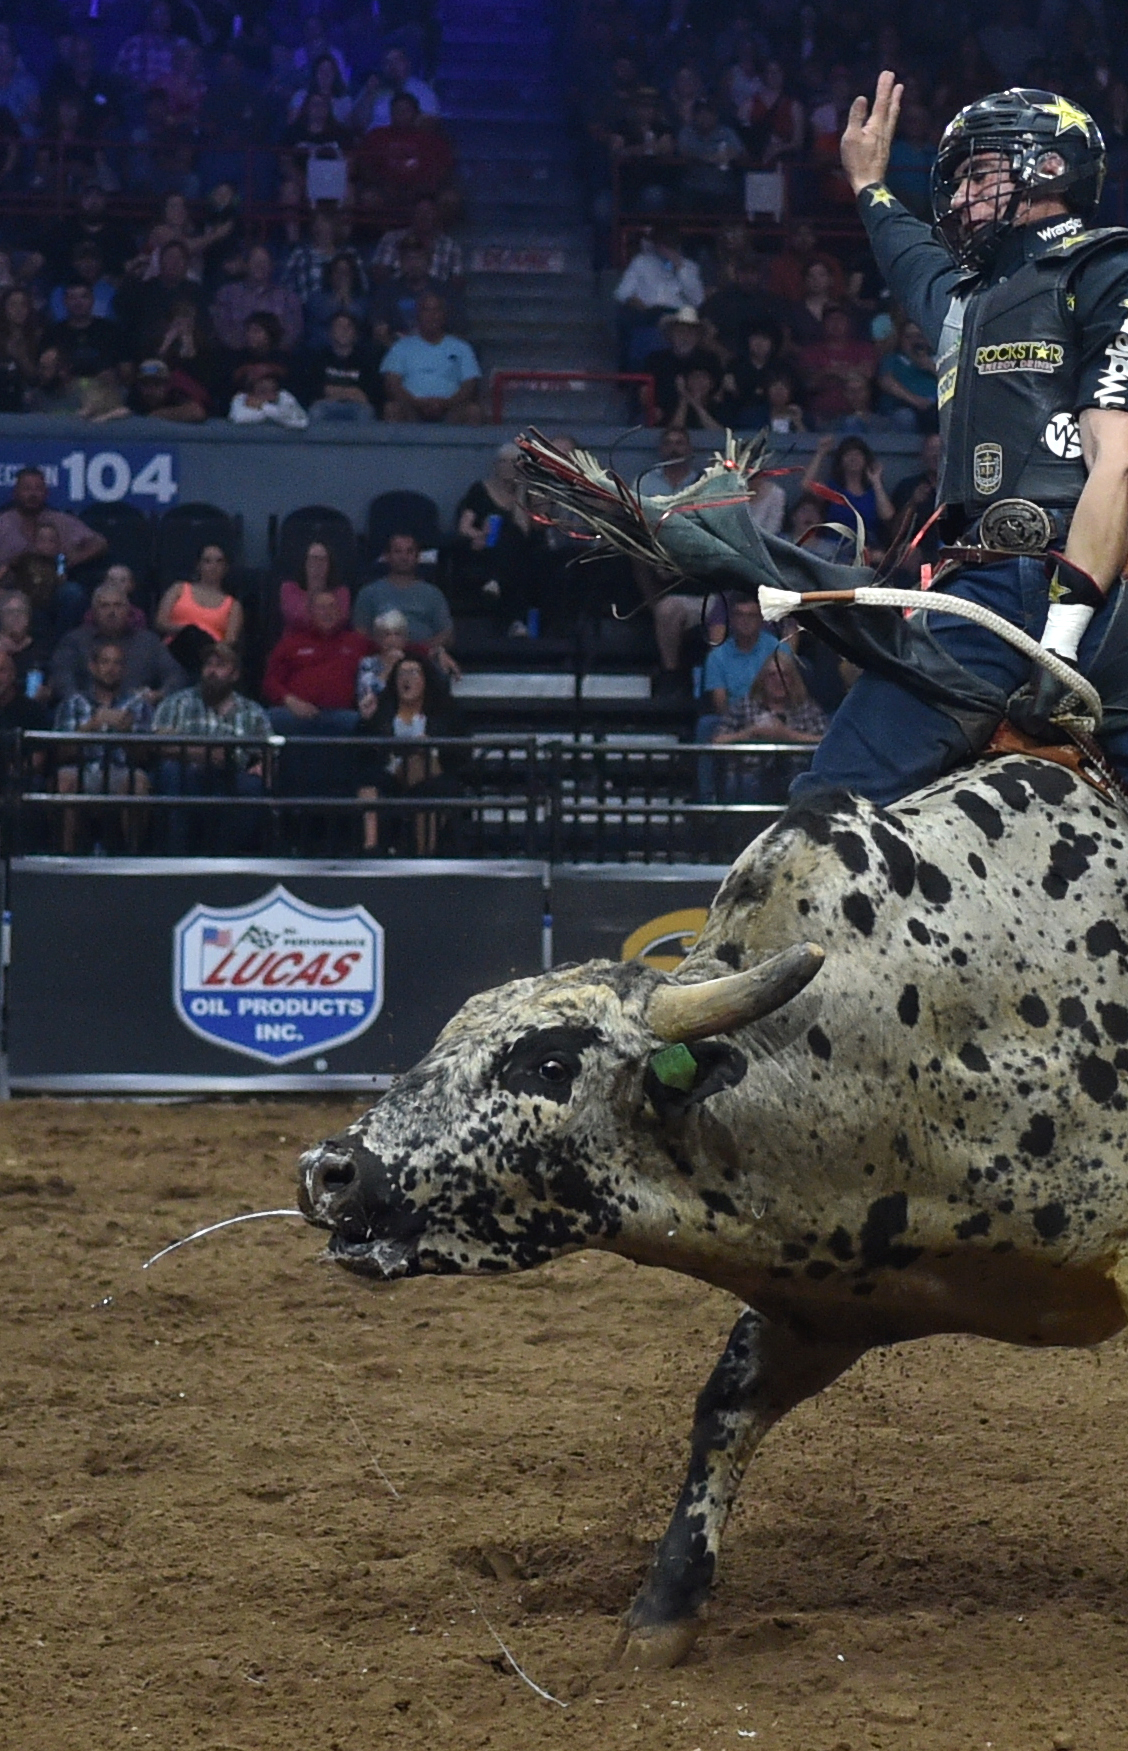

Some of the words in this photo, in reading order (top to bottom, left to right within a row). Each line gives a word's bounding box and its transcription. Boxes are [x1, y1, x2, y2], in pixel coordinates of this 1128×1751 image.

[61, 452, 178, 503] 104
[202, 951, 363, 986] LUCAS
[190, 998, 231, 1016] OIL
[238, 998, 365, 1016] PRODUCTS
[255, 1023, 304, 1042] INC.
